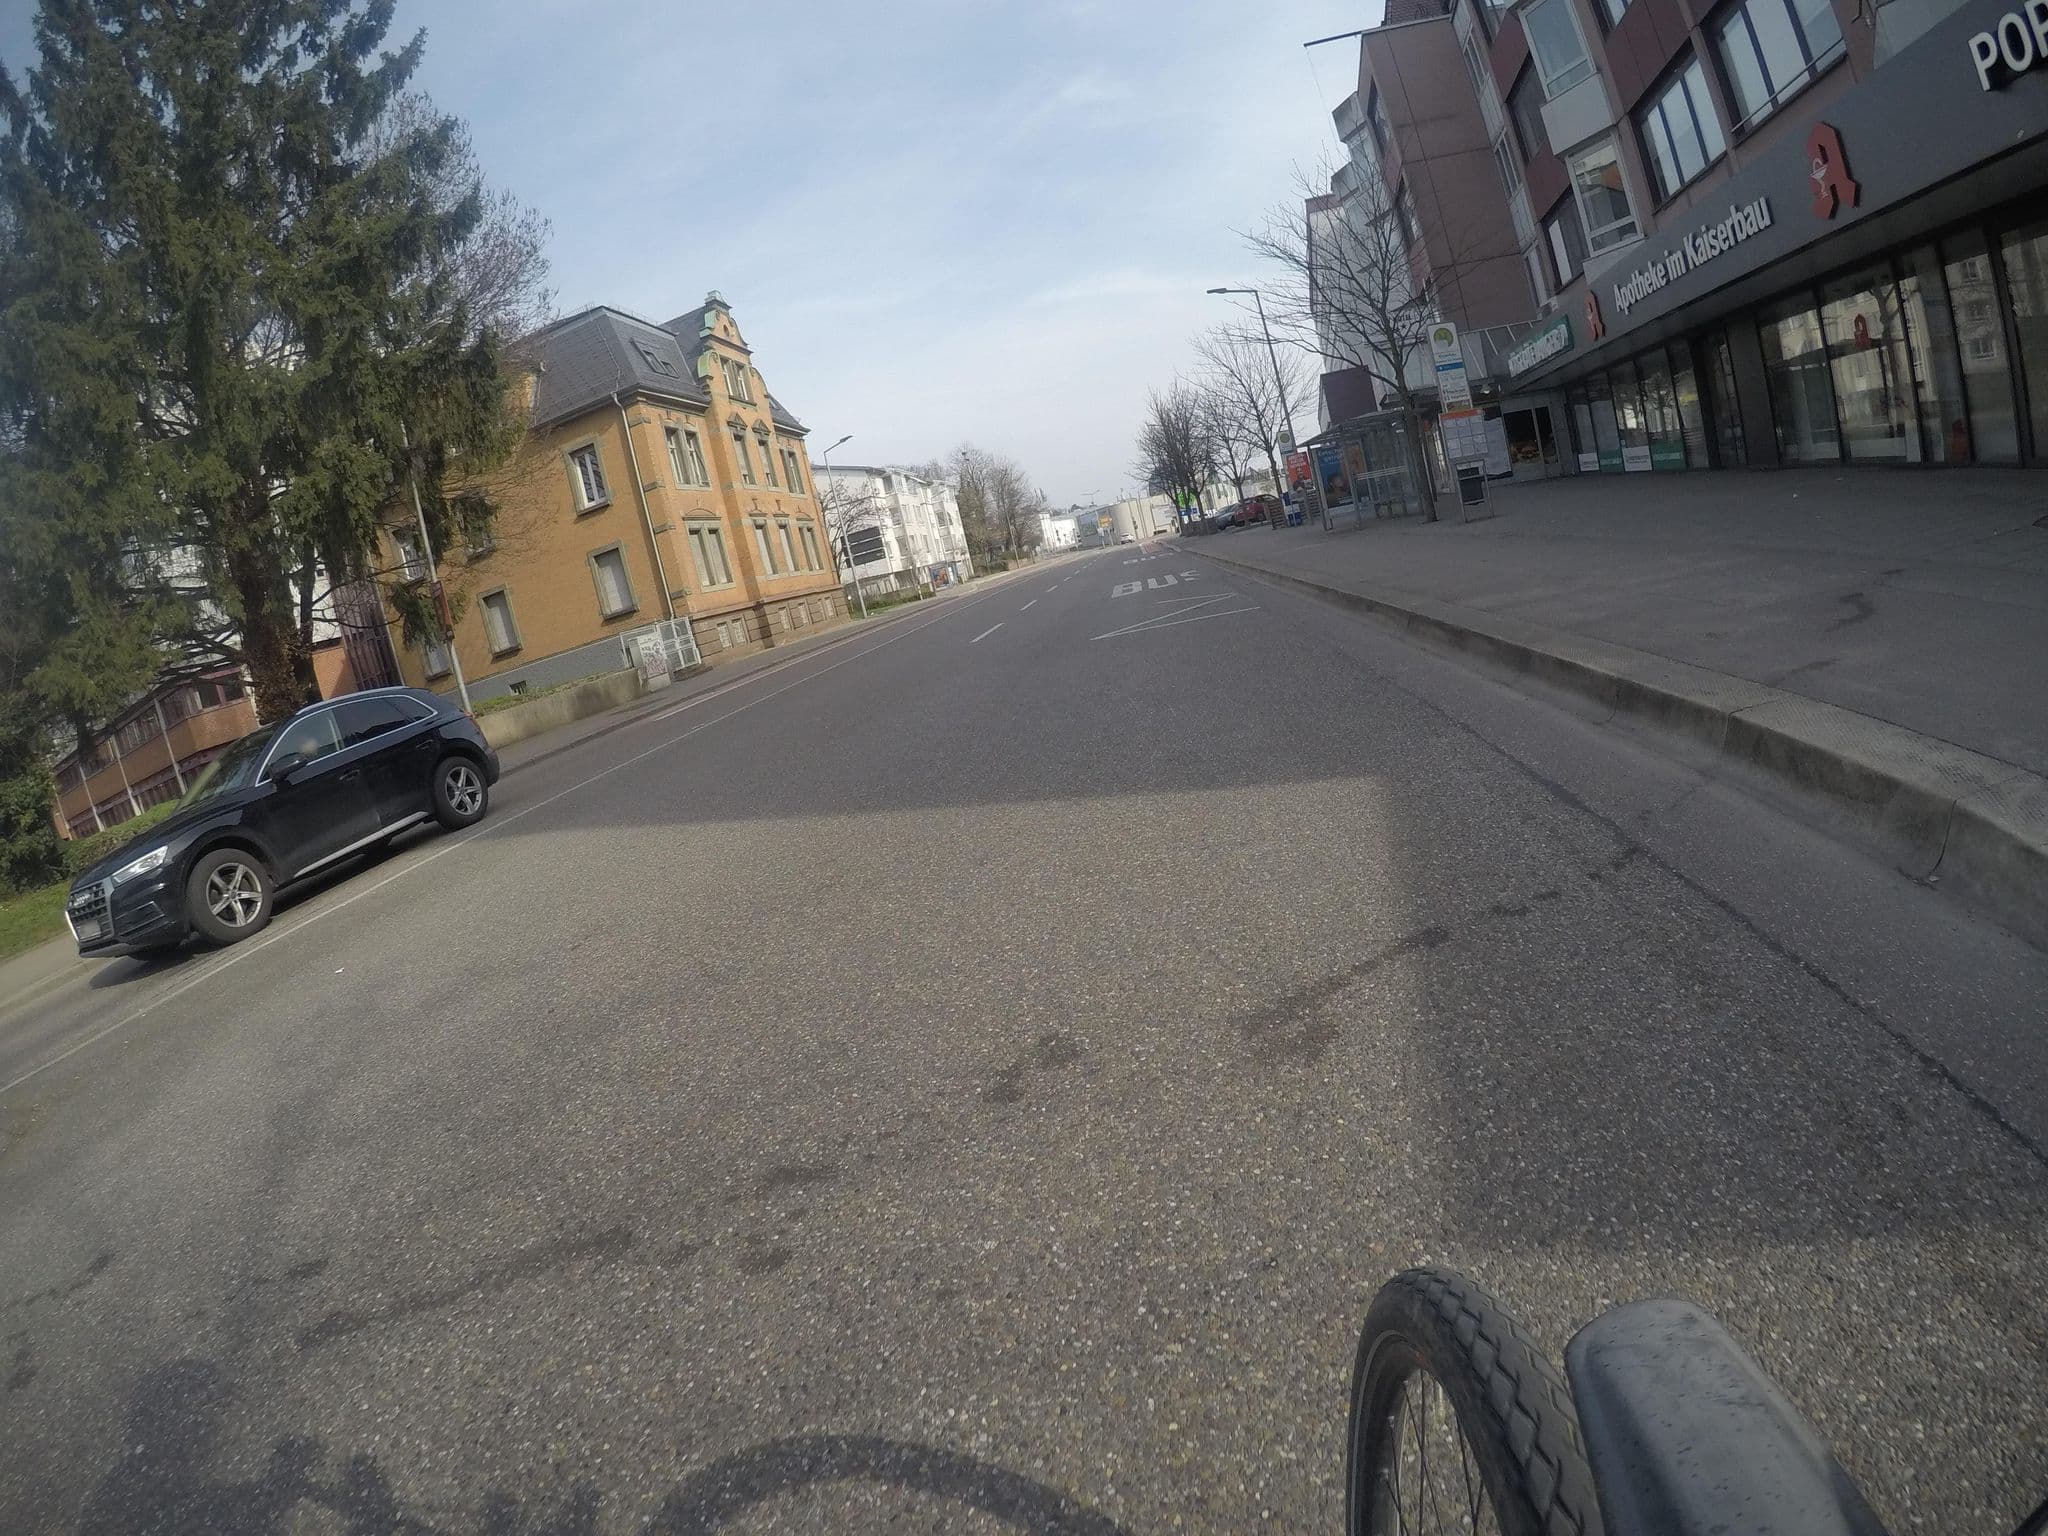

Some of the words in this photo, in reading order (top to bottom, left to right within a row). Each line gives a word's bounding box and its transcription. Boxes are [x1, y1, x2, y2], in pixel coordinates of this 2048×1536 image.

[1612, 260, 1667, 315] Apotheke
[1663, 248, 1688, 282] im
[1682, 195, 1773, 271] Kaiserbau
